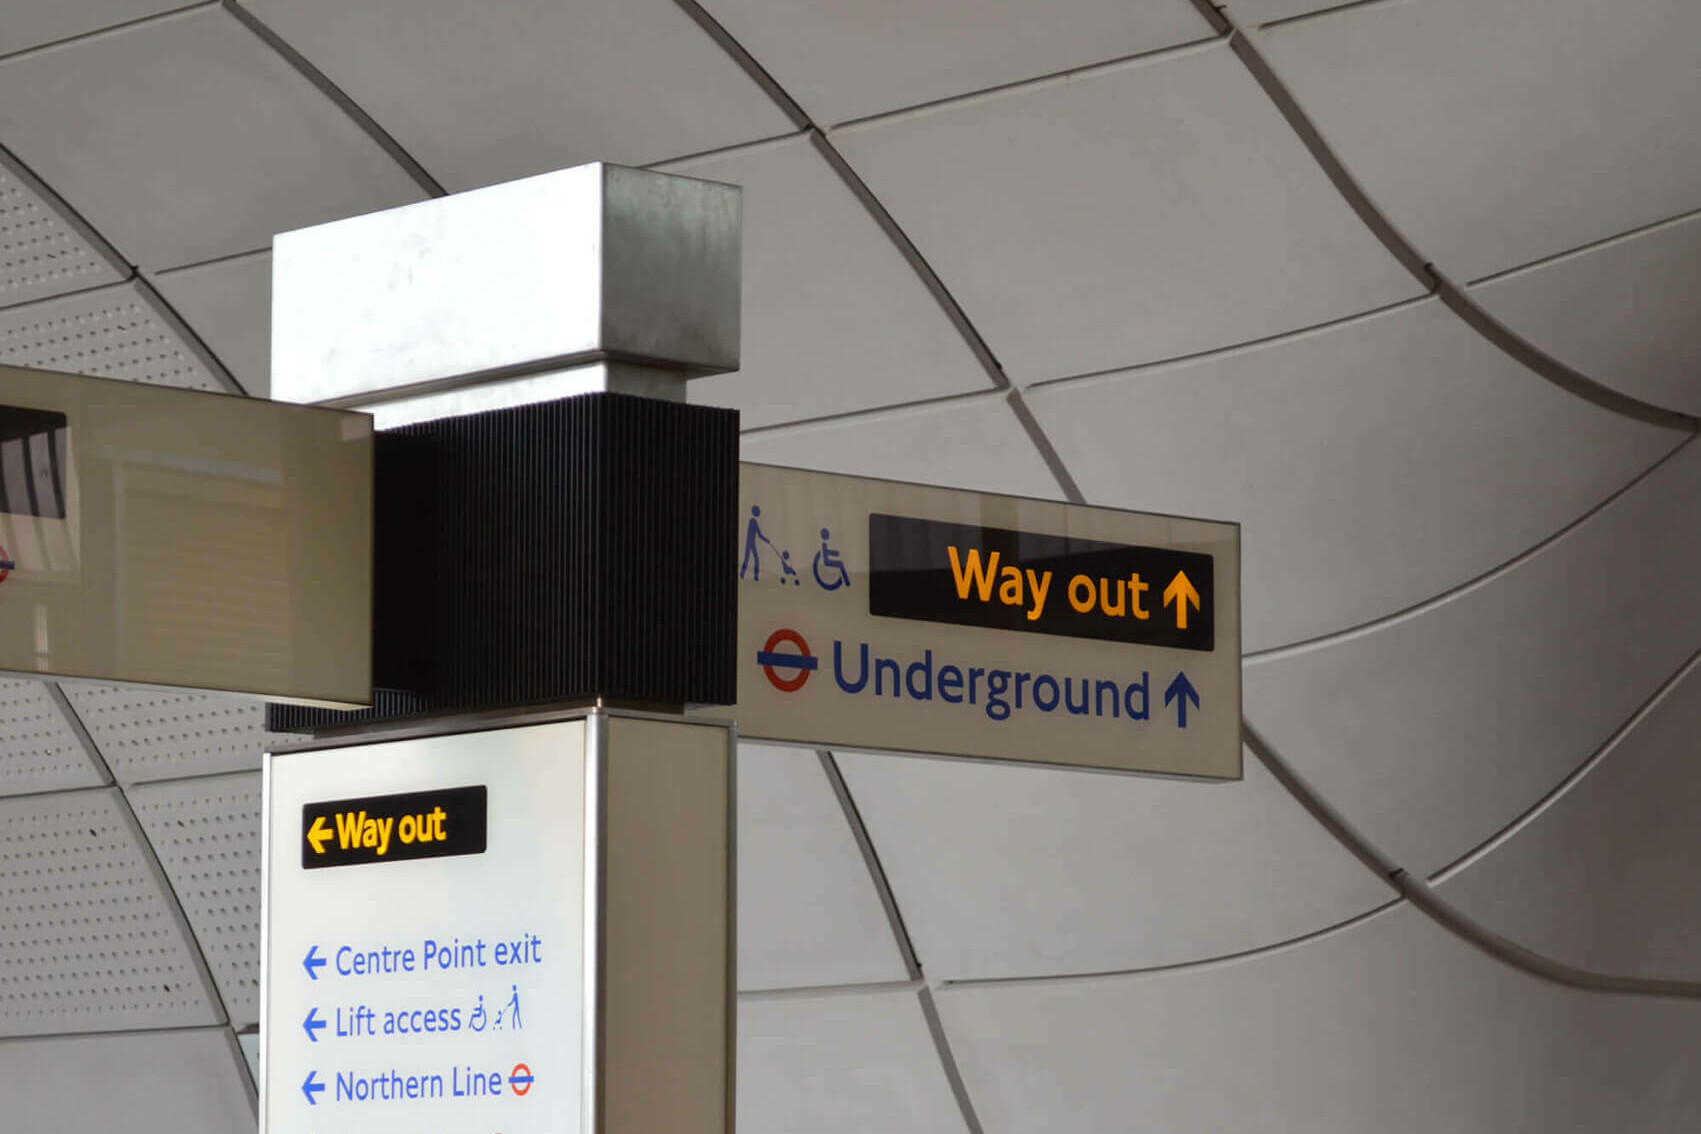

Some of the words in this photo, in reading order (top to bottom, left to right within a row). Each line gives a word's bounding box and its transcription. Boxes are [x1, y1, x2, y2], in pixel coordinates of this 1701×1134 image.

[947, 546, 1052, 621] Way
[1068, 573, 1150, 620] out
[834, 640, 1150, 721] Underground
[335, 812, 393, 855] Way
[399, 806, 447, 844] out
[336, 945, 415, 976] Centre
[424, 938, 487, 970] Point
[494, 933, 542, 965] exit
[336, 1005, 376, 1037] Lift
[384, 1006, 462, 1034] access
[336, 1068, 443, 1101] Northern
[453, 1066, 502, 1096] Line
